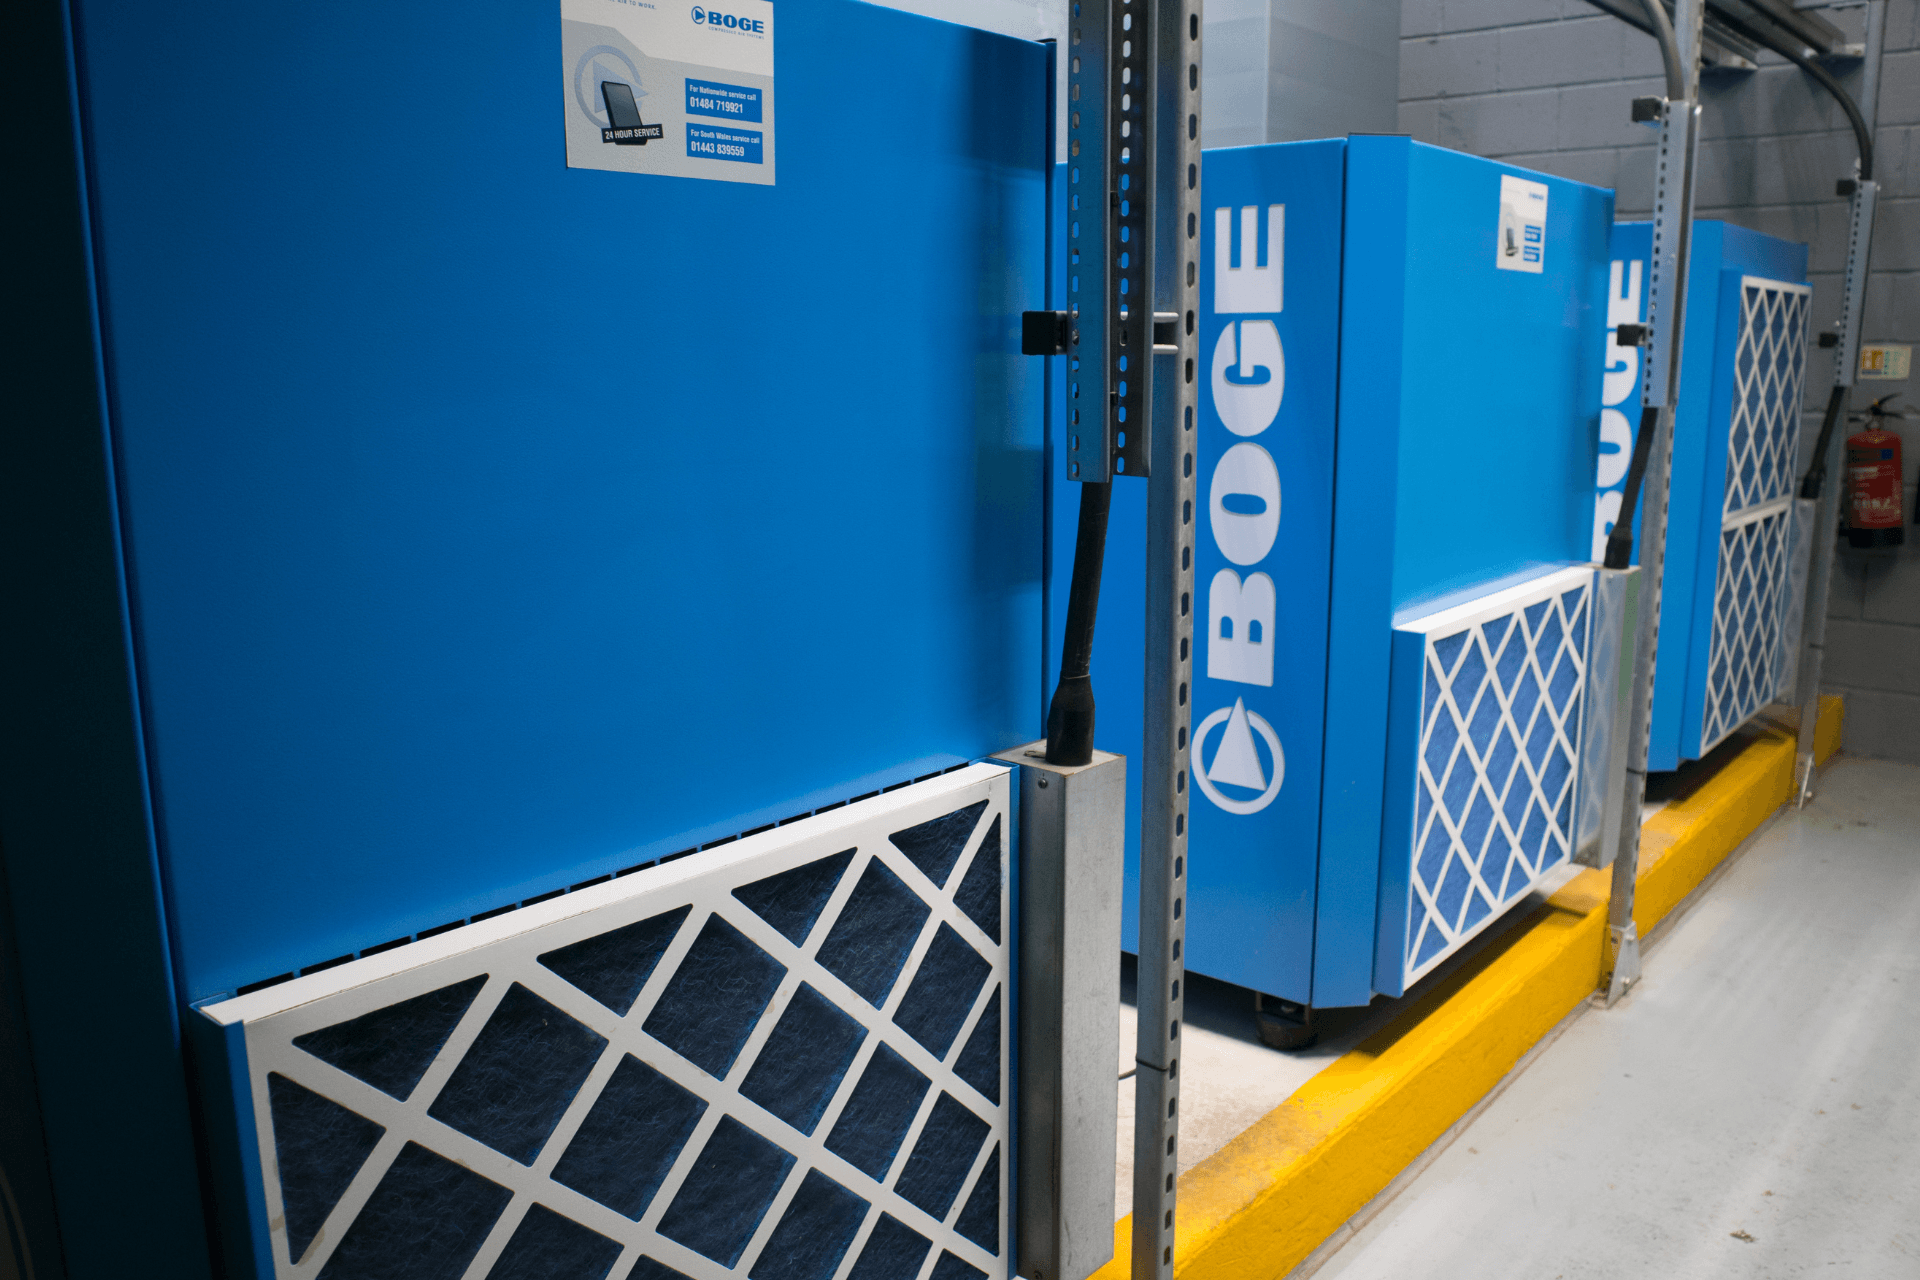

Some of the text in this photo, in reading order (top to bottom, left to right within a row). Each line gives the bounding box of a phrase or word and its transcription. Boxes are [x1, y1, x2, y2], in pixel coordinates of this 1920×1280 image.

[638, 2, 656, 10] WORK.
[708, 11, 764, 34] BOGE
[690, 84, 698, 92] For
[699, 86, 727, 97] Nationwide
[728, 91, 746, 99] service
[690, 97, 743, 113] 01484 719921
[605, 127, 660, 139] 24 HOUR SERVICE
[700, 130, 715, 138] South
[716, 132, 731, 140] Wales
[691, 140, 744, 156] 01443 839559
[1207, 203, 1286, 688] BOGE
